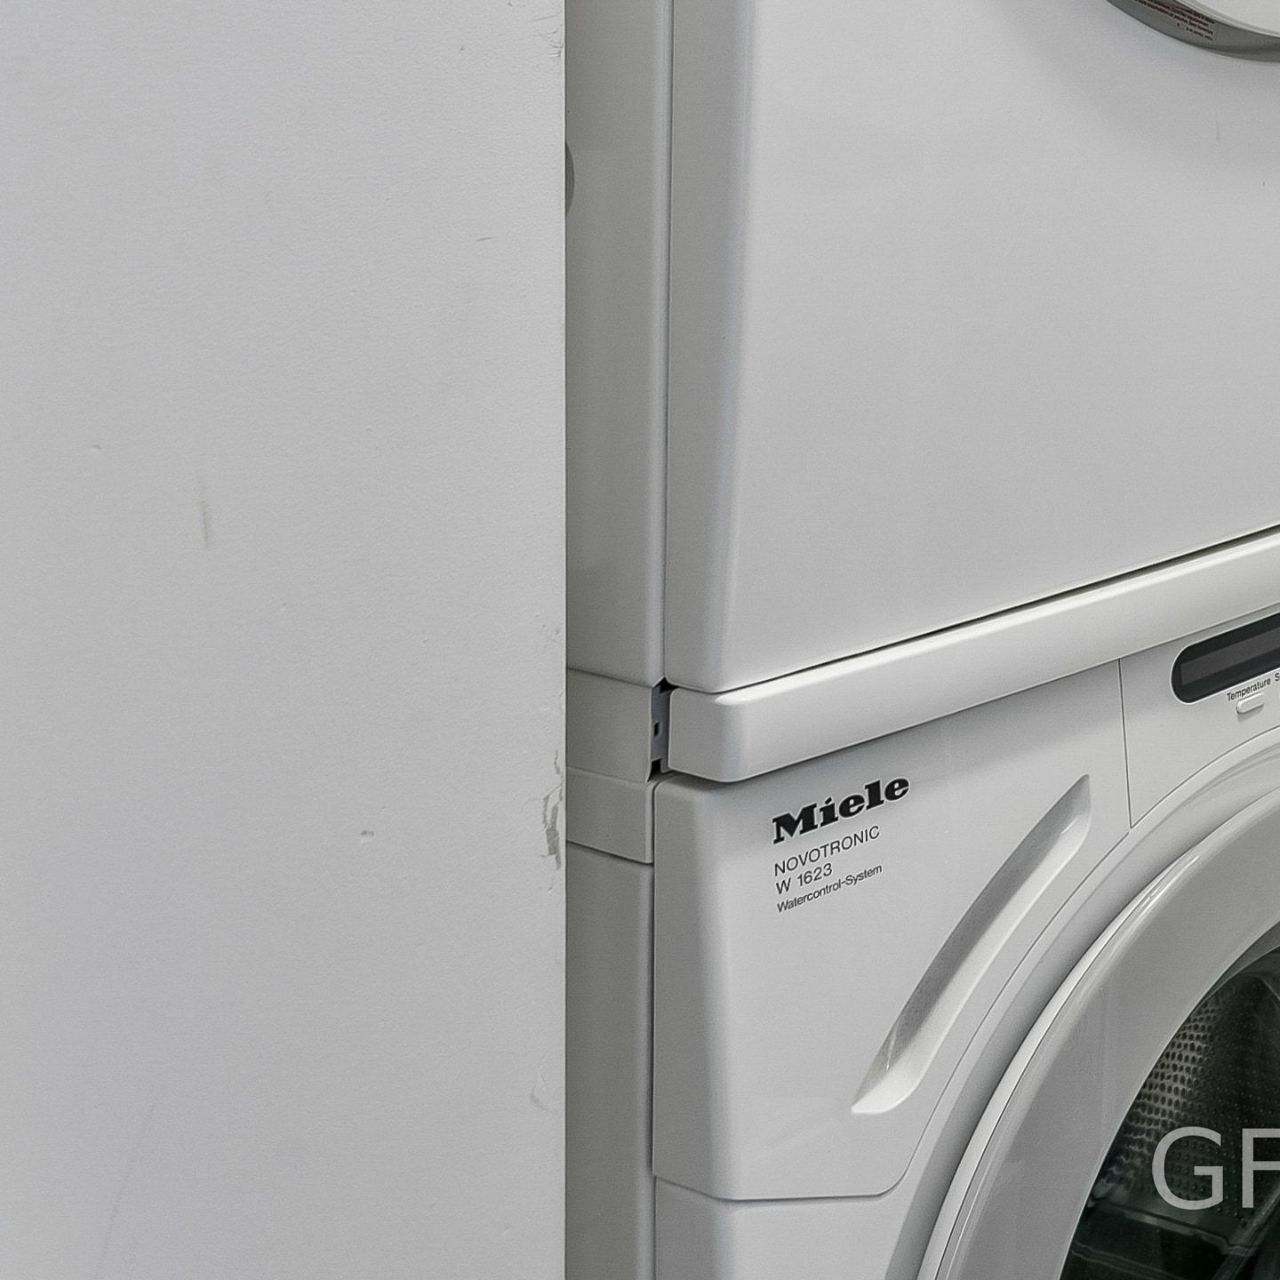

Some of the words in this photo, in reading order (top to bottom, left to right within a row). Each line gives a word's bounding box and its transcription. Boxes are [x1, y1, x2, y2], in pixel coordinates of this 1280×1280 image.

[1226, 677, 1271, 701] Temperature
[772, 777, 909, 844] Miele
[774, 825, 880, 877] NOVOTRONIC
[776, 877, 792, 895] W
[797, 862, 833, 887] 1623
[777, 864, 883, 913] Watercontrol-System
